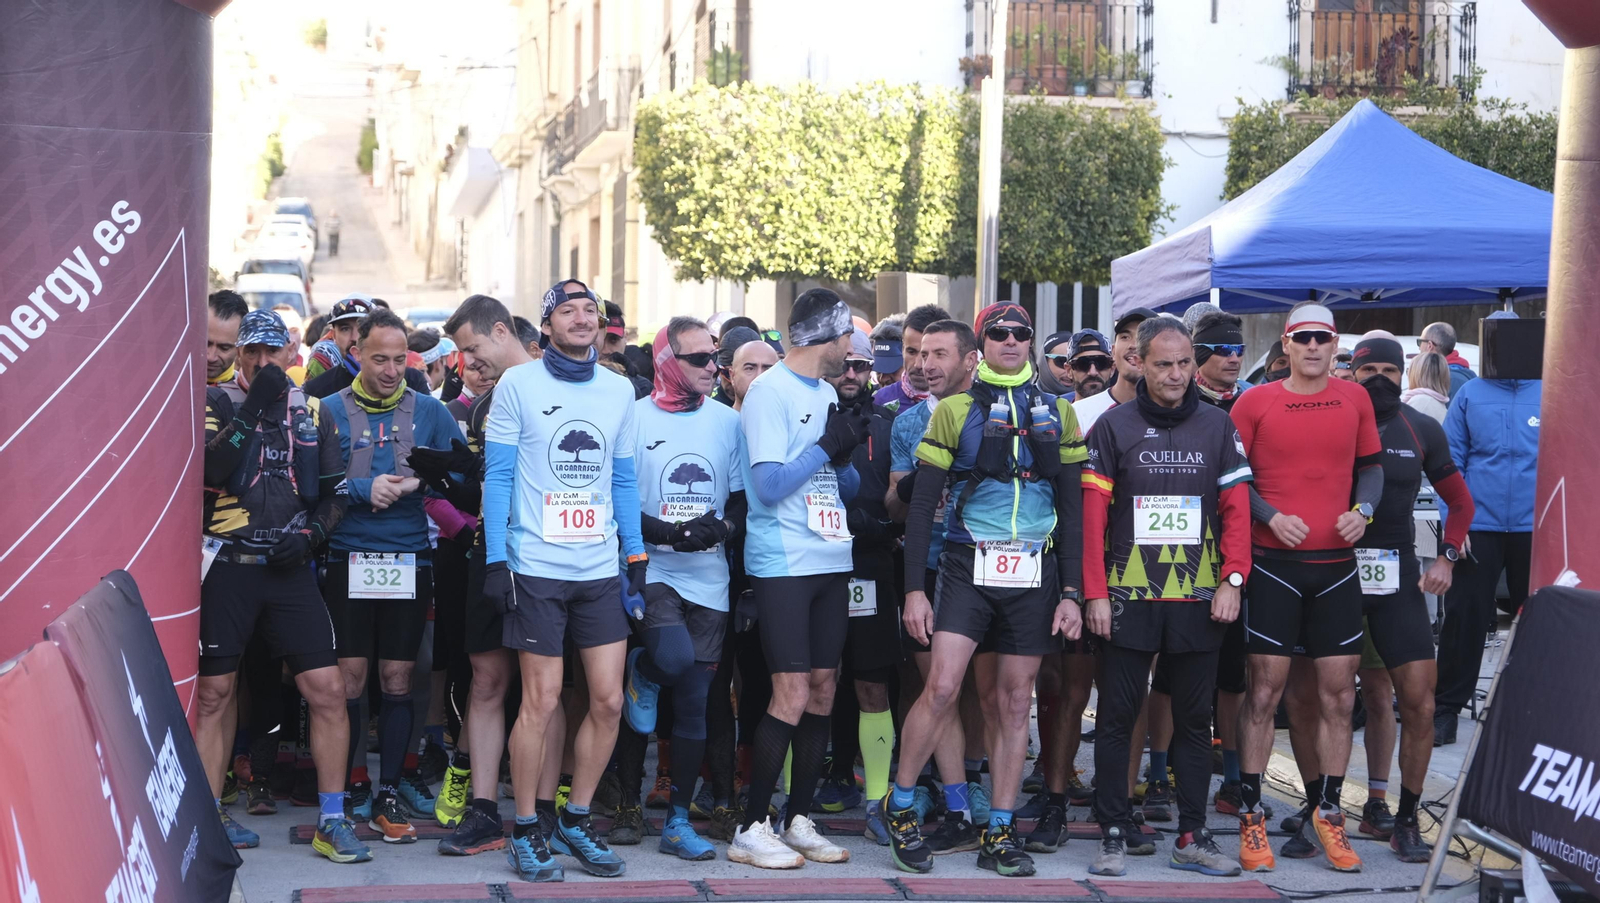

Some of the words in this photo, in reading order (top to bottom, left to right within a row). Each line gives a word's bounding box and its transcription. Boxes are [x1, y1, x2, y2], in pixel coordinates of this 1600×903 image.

[1285, 400, 1342, 409] WONG
[1139, 450, 1204, 464] CUELLAR
[558, 508, 596, 529] 108
[818, 509, 841, 530] 113
[1148, 512, 1188, 531] 245
[996, 554, 1022, 574] 87
[363, 567, 402, 586] 332
[1518, 743, 1600, 823] TEAM
